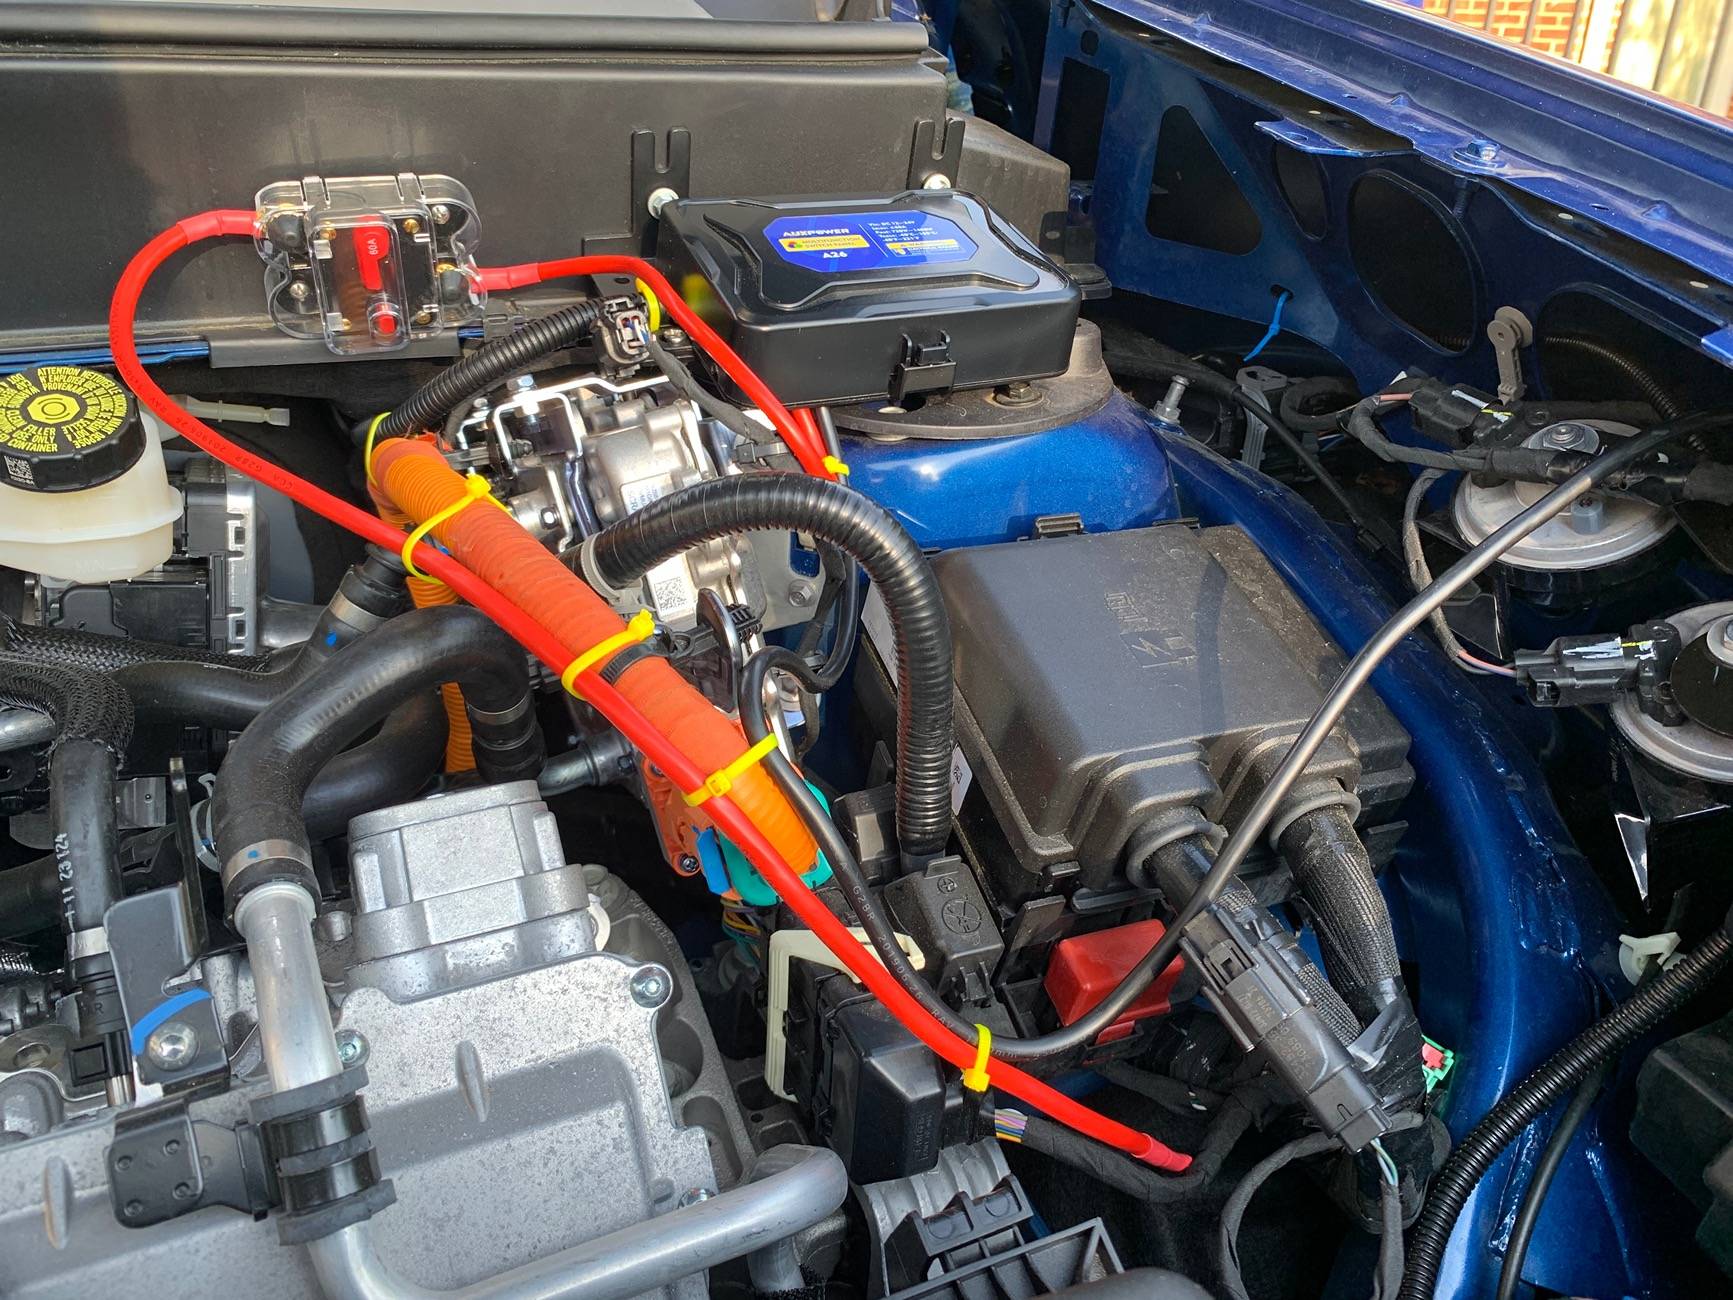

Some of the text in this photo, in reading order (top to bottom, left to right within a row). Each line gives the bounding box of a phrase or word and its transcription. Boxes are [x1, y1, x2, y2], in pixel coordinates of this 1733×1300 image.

[783, 228, 850, 237] AUXPOWER
[823, 251, 848, 259] A26
[38, 367, 81, 377] ATTENTION
[43, 381, 89, 396] PROVENANT
[107, 386, 123, 396] LE
[12, 429, 32, 441] USE
[31, 434, 55, 444] ONLY
[23, 423, 56, 436] FILLER
[7, 437, 58, 453] CONTAINER
[72, 431, 106, 449] DEPOSE
[852, 885, 877, 921] G28R
